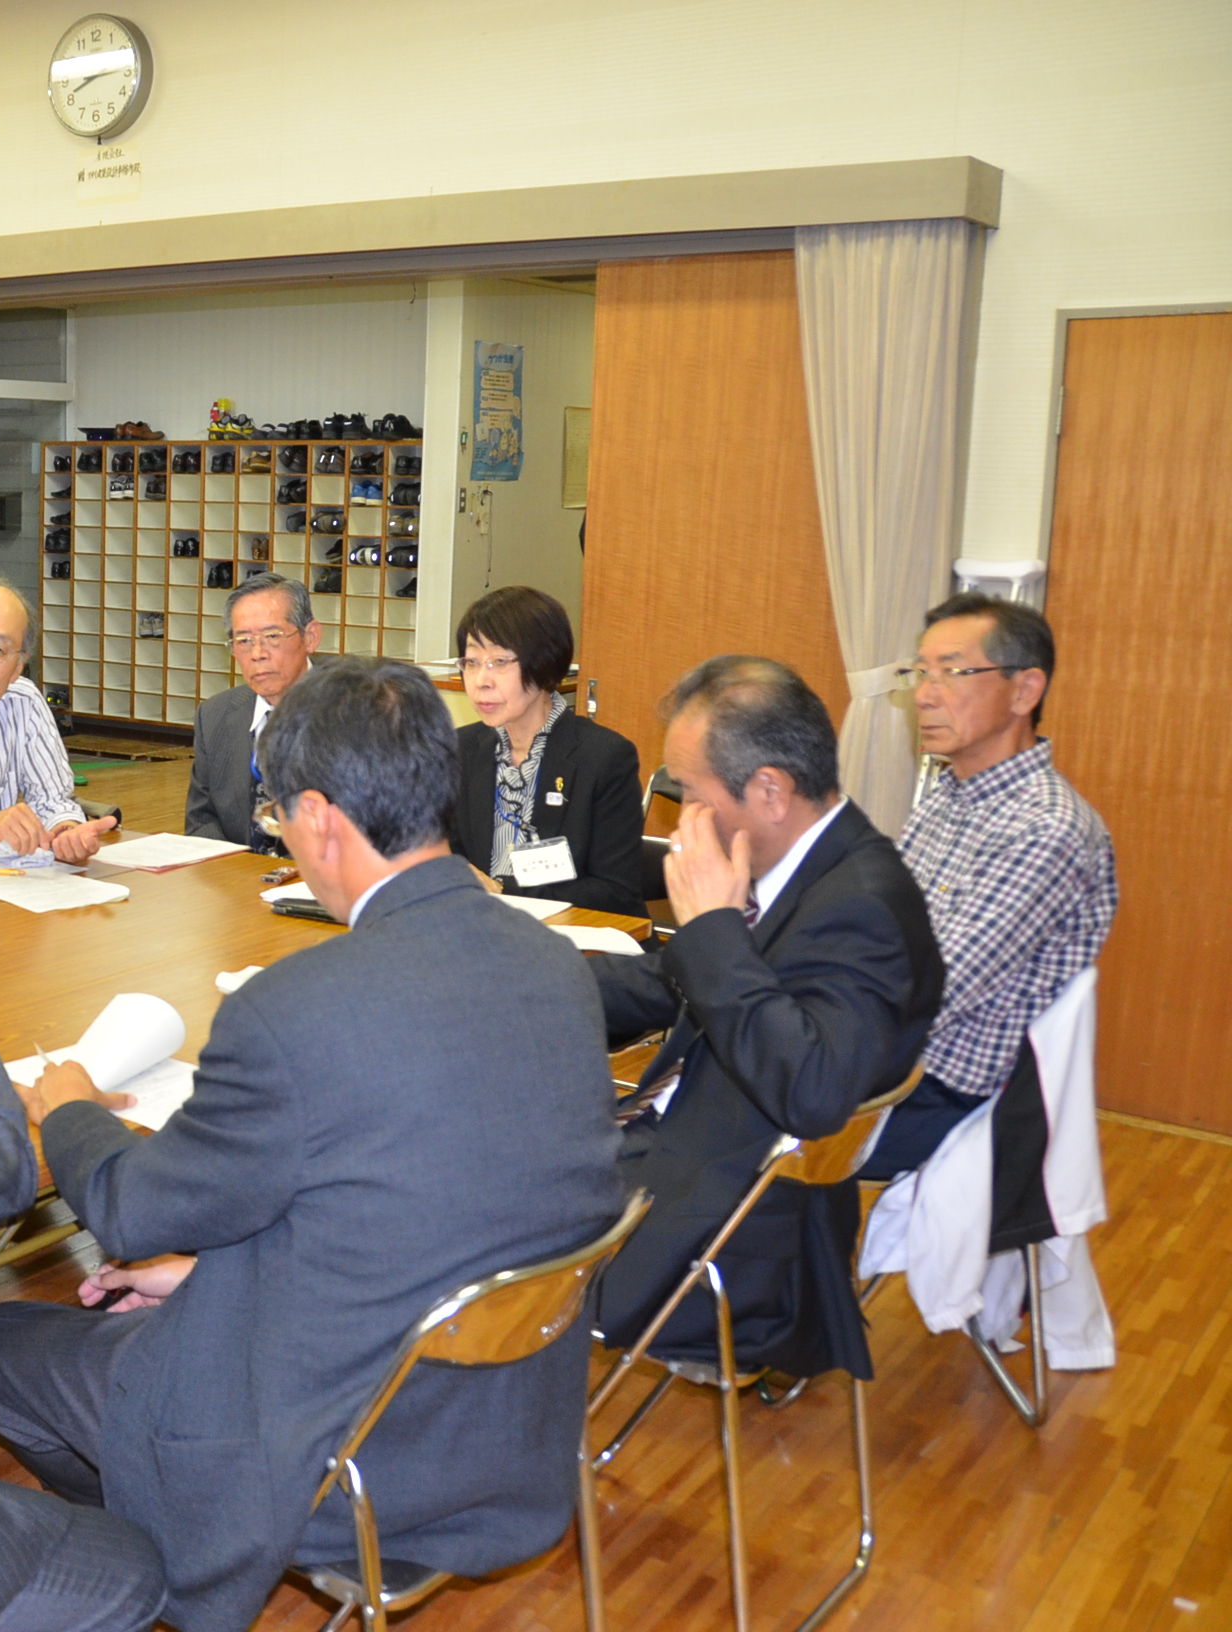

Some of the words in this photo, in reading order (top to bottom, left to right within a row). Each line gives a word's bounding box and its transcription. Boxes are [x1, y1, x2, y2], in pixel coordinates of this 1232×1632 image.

[91, 29, 102, 42] 12
[109, 32, 114, 44] 1
[77, 38, 86, 51] 11
[61, 75, 69, 88] 9
[119, 85, 127, 97] 4
[67, 93, 75, 106] 8
[79, 107, 86, 119] 7
[107, 102, 115, 115] 5
[92, 109, 100, 122] 6
